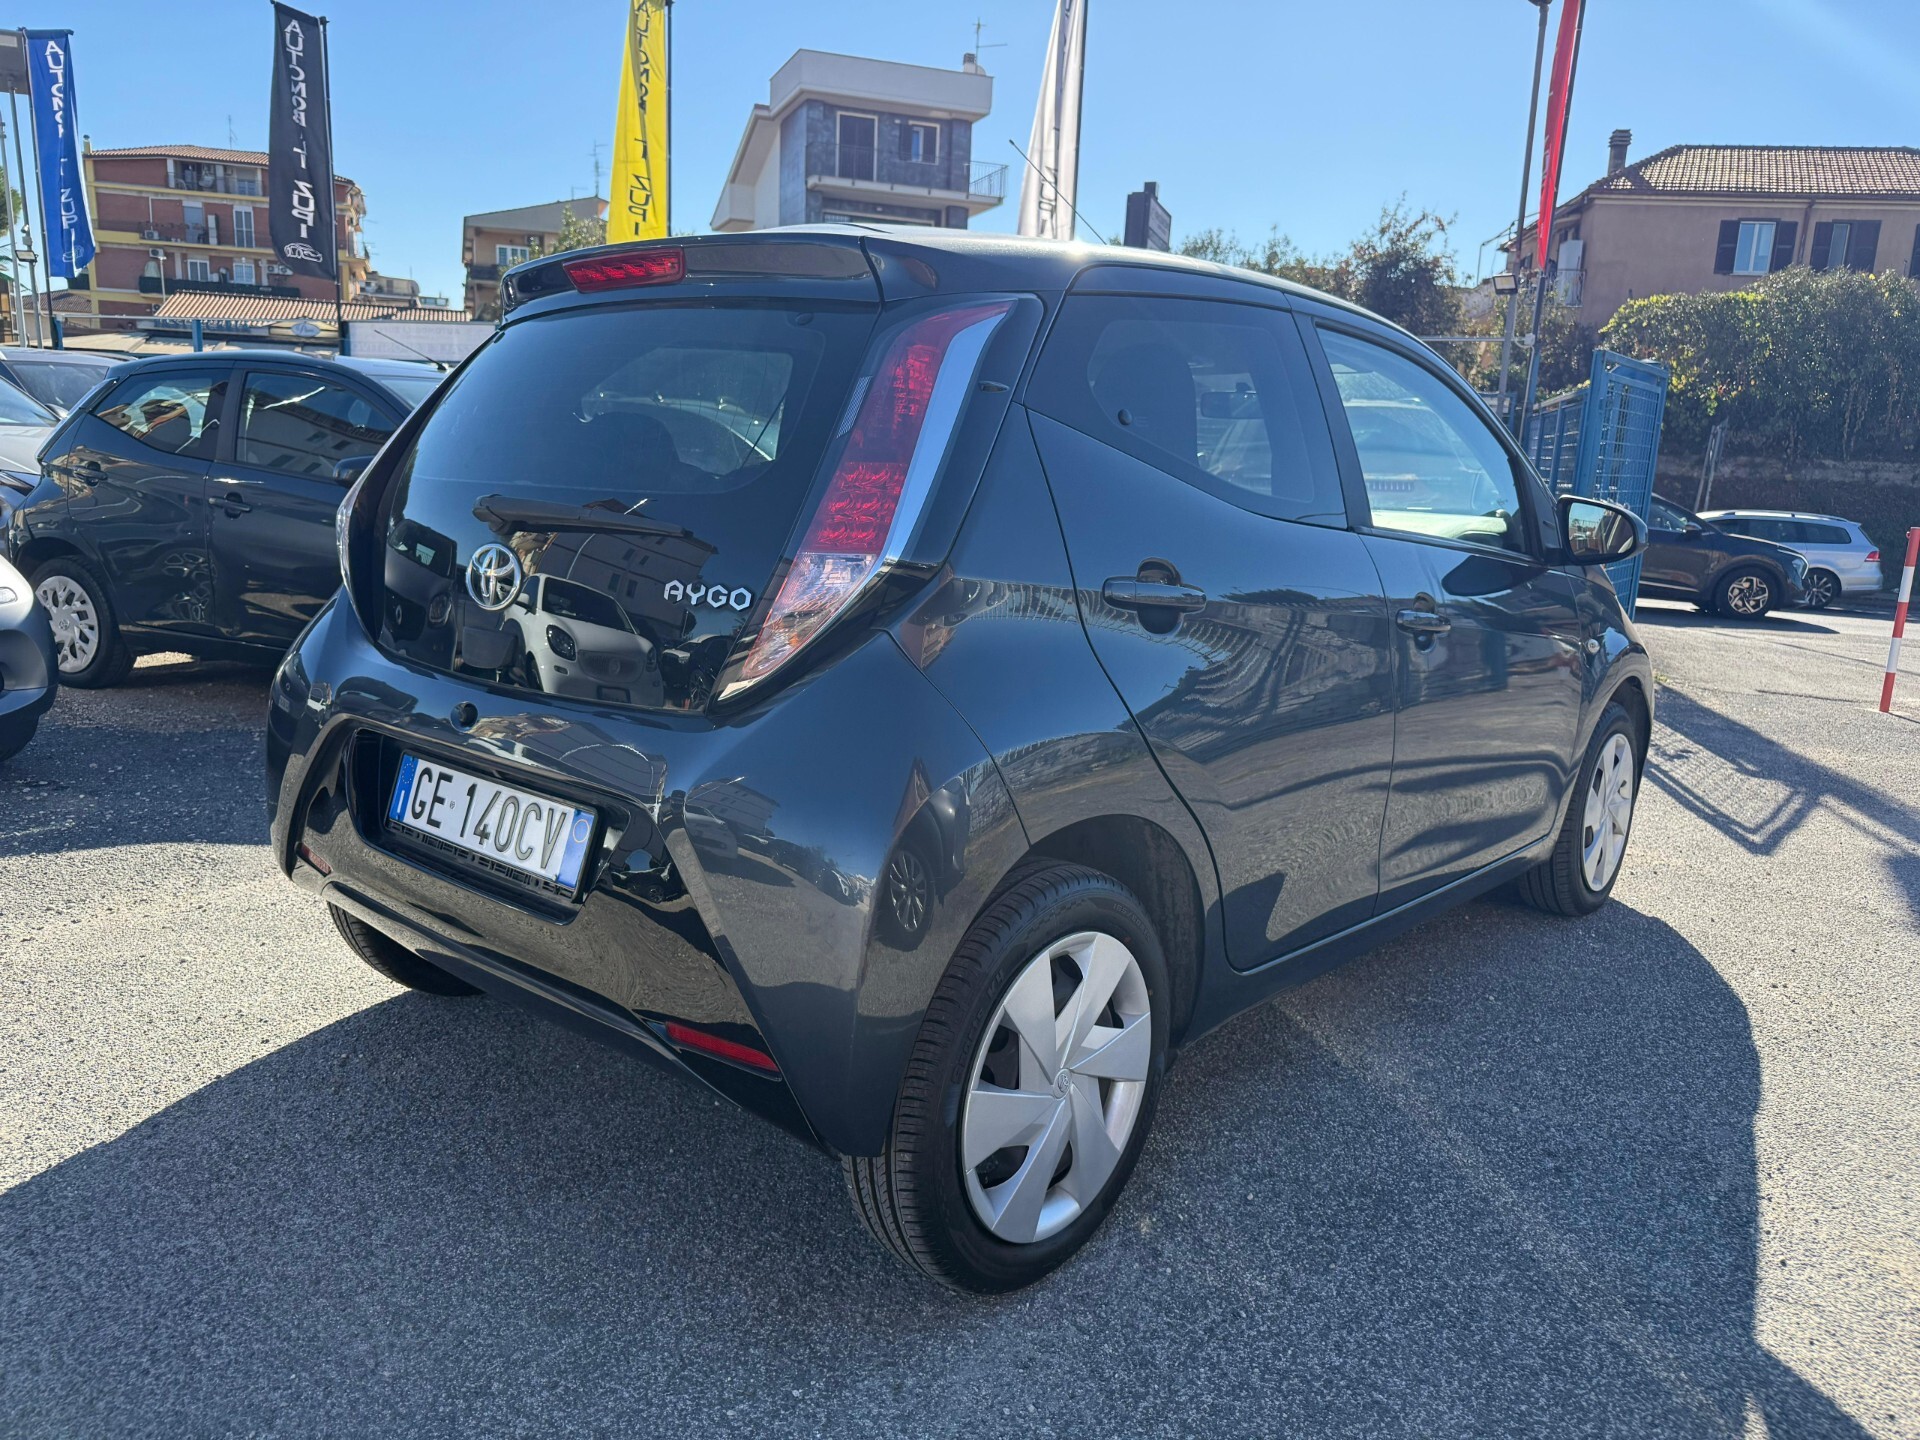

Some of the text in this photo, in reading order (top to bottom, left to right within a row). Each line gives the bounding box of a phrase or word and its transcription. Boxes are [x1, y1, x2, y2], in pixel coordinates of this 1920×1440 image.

[663, 579, 752, 611] AYGO
[410, 766, 454, 829] GE
[459, 782, 568, 870] 140CV
